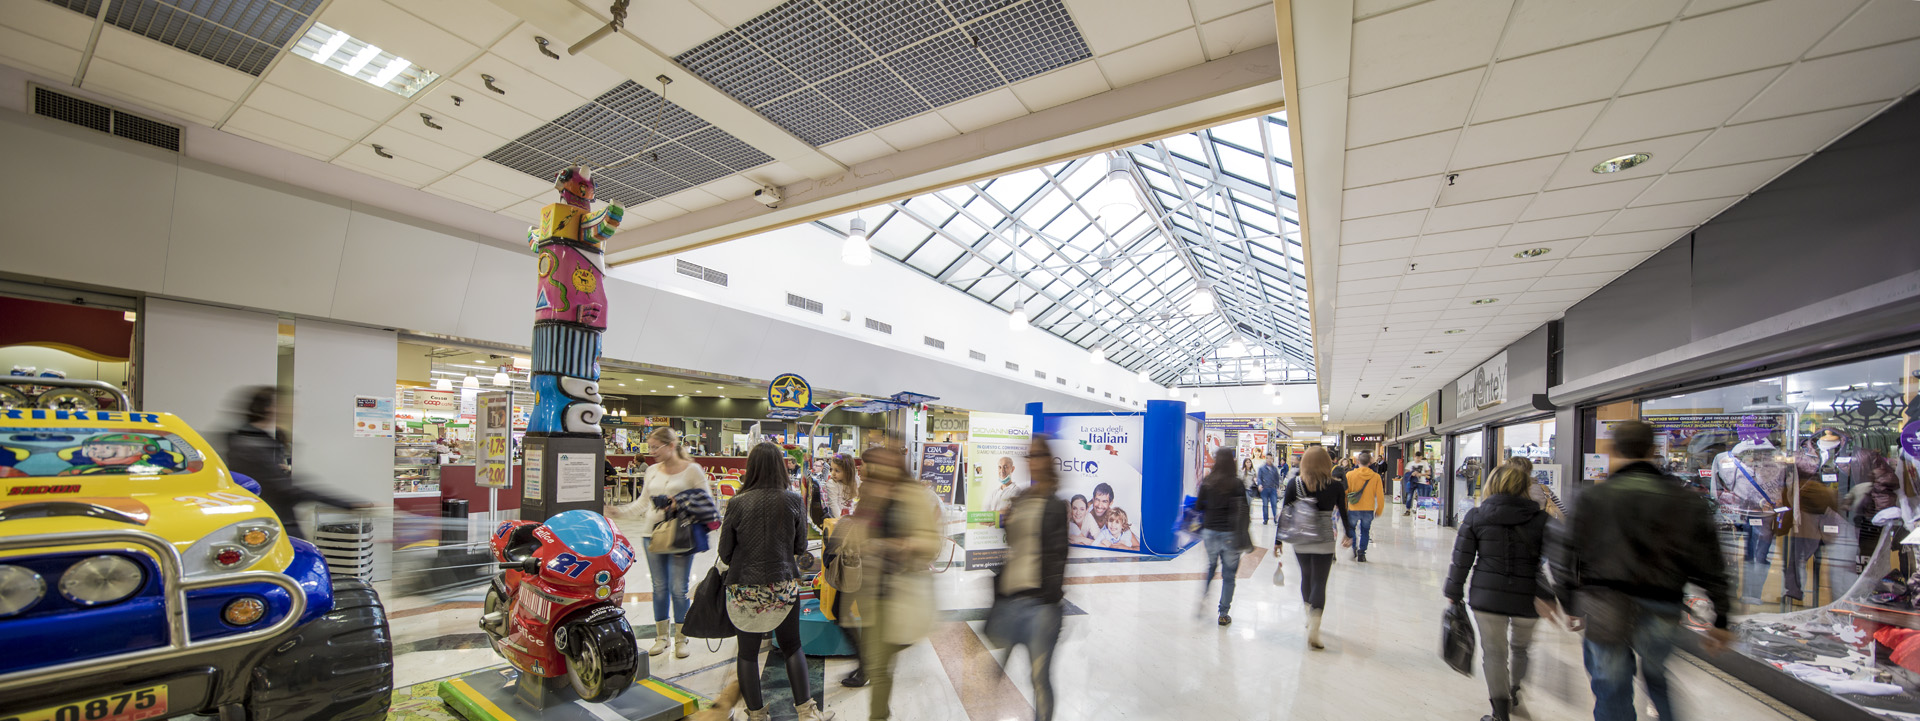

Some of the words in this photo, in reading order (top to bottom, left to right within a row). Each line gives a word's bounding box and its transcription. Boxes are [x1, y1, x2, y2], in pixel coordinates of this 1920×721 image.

[1106, 425, 1124, 434] degli
[1089, 432, 1128, 444] Italiani
[490, 438, 505, 455] 1,75
[489, 467, 505, 483] 2,00
[939, 465, 955, 474] 9,90
[936, 485, 951, 493] 11,50
[534, 525, 555, 544] Felice
[545, 552, 592, 579] 21
[513, 616, 545, 647] Felice
